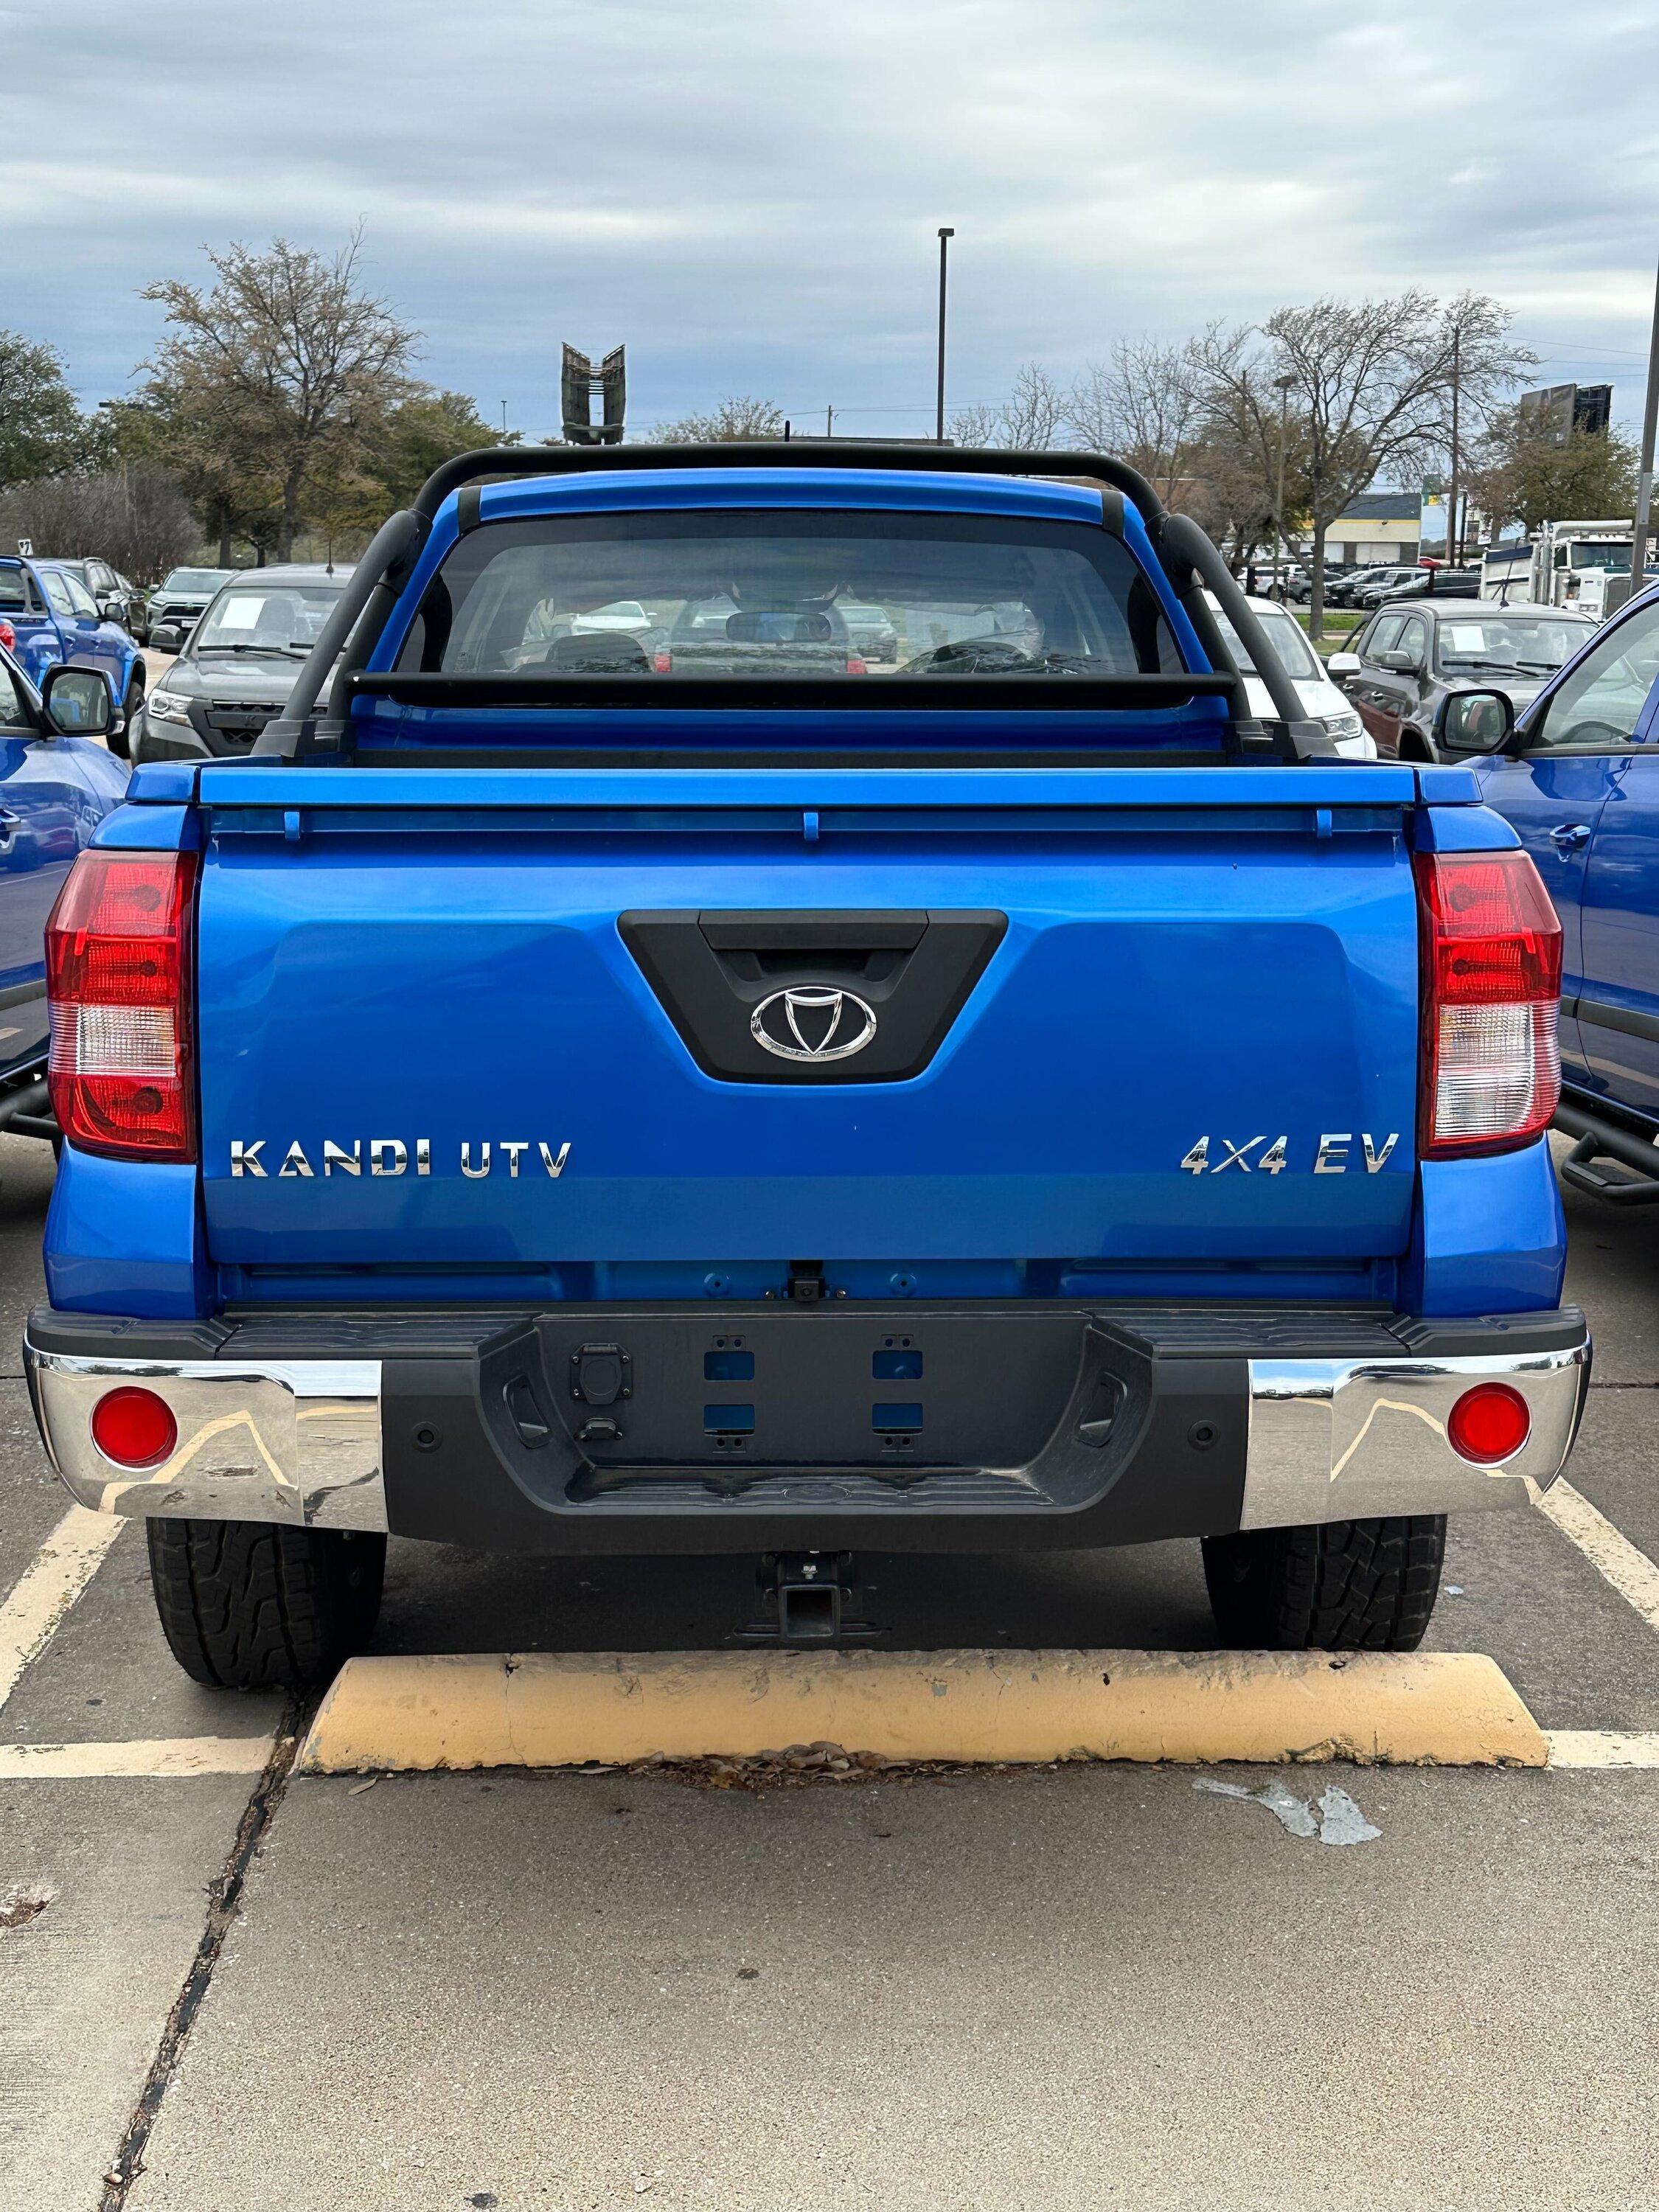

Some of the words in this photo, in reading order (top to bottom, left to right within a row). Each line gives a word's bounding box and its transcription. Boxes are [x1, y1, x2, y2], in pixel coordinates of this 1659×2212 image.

[230, 1139, 430, 1178] KANDI
[460, 1142, 571, 1178] UTV
[1314, 1133, 1399, 1174] EV
